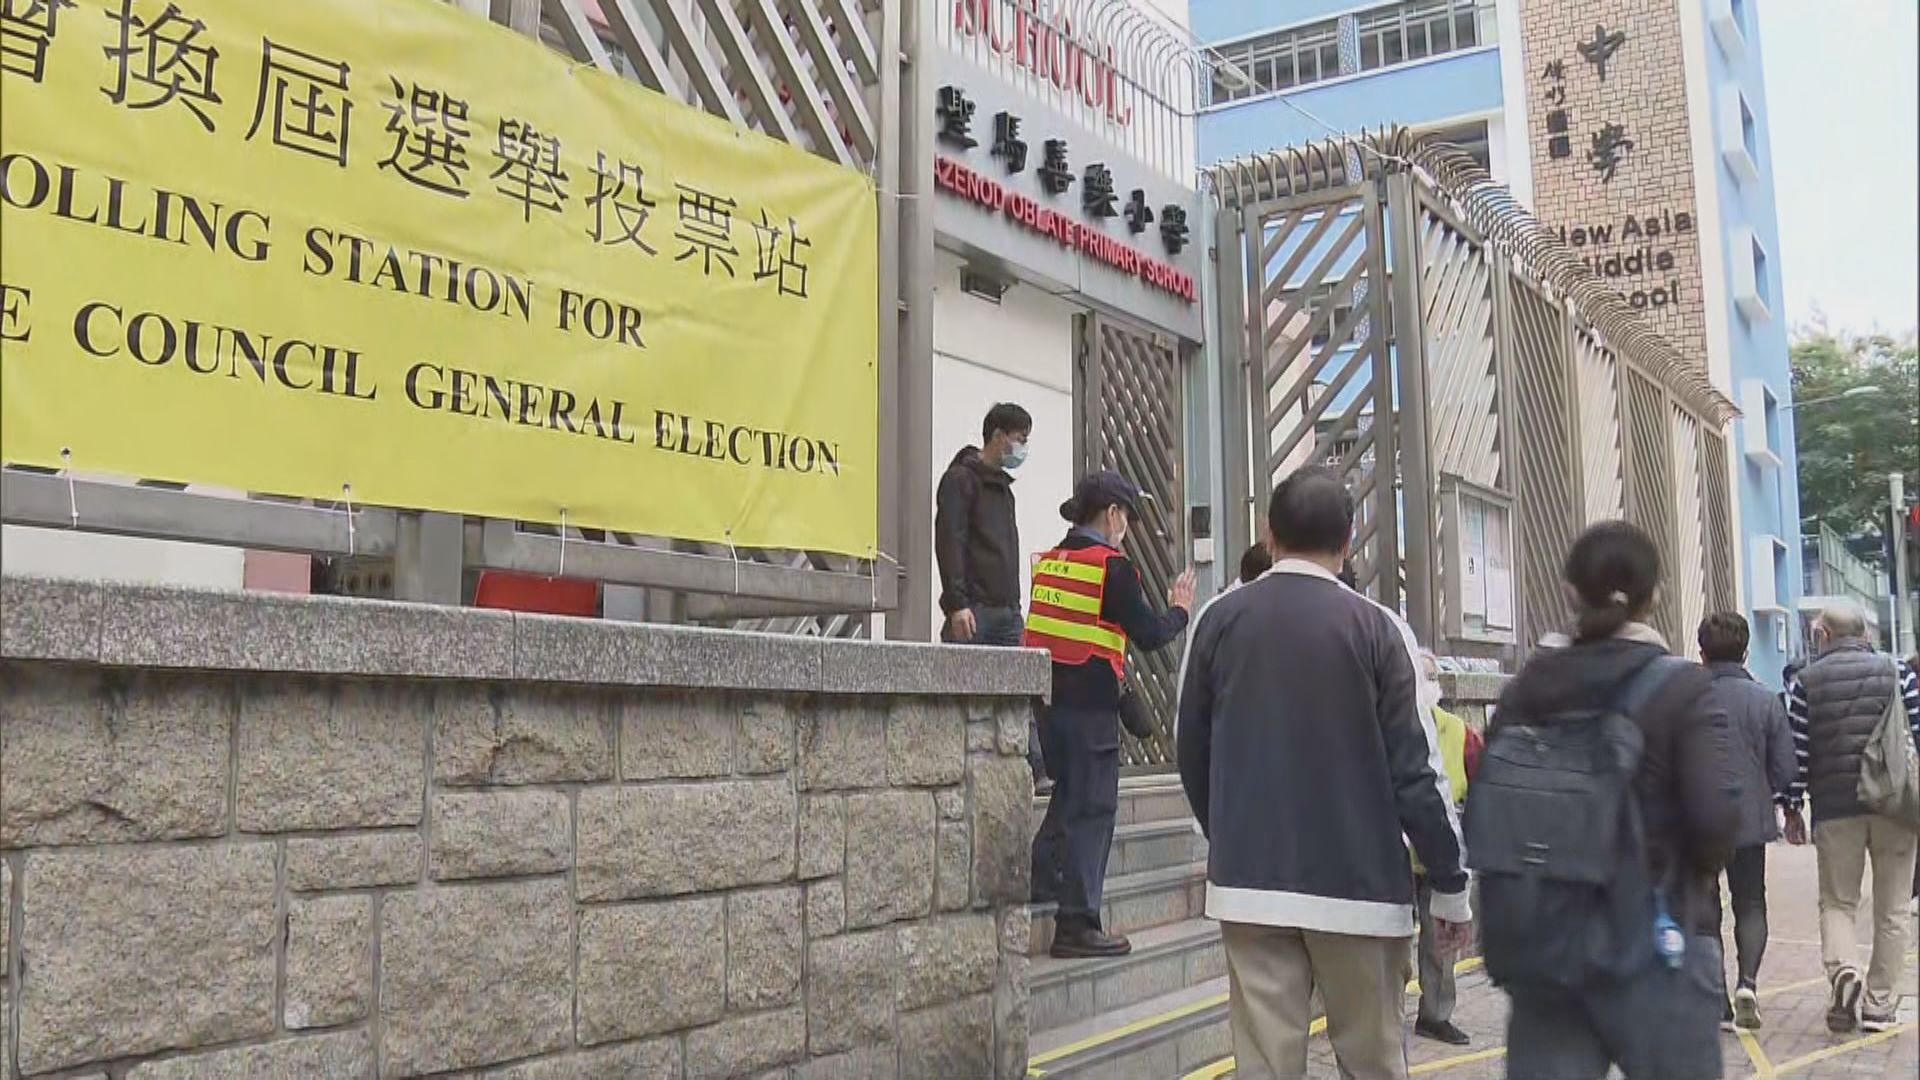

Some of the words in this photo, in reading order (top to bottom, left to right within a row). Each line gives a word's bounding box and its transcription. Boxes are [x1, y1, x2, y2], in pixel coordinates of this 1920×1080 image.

[1622, 208, 1692, 241] Asia
[1, 152, 272, 262] OLLING
[303, 227, 534, 324] STATION
[557, 288, 647, 349] FOR
[1009, 191, 1075, 246] OBLATE
[1078, 223, 1143, 276] PRIMARY
[1144, 257, 1198, 303] SCHOOL
[1583, 246, 1674, 277] iddle
[1616, 280, 1678, 308] ool
[74, 302, 377, 400] COUNCIL
[405, 362, 635, 444] GENERAL
[653, 409, 841, 477] ELECTION
[1034, 587, 1062, 603] CAS
